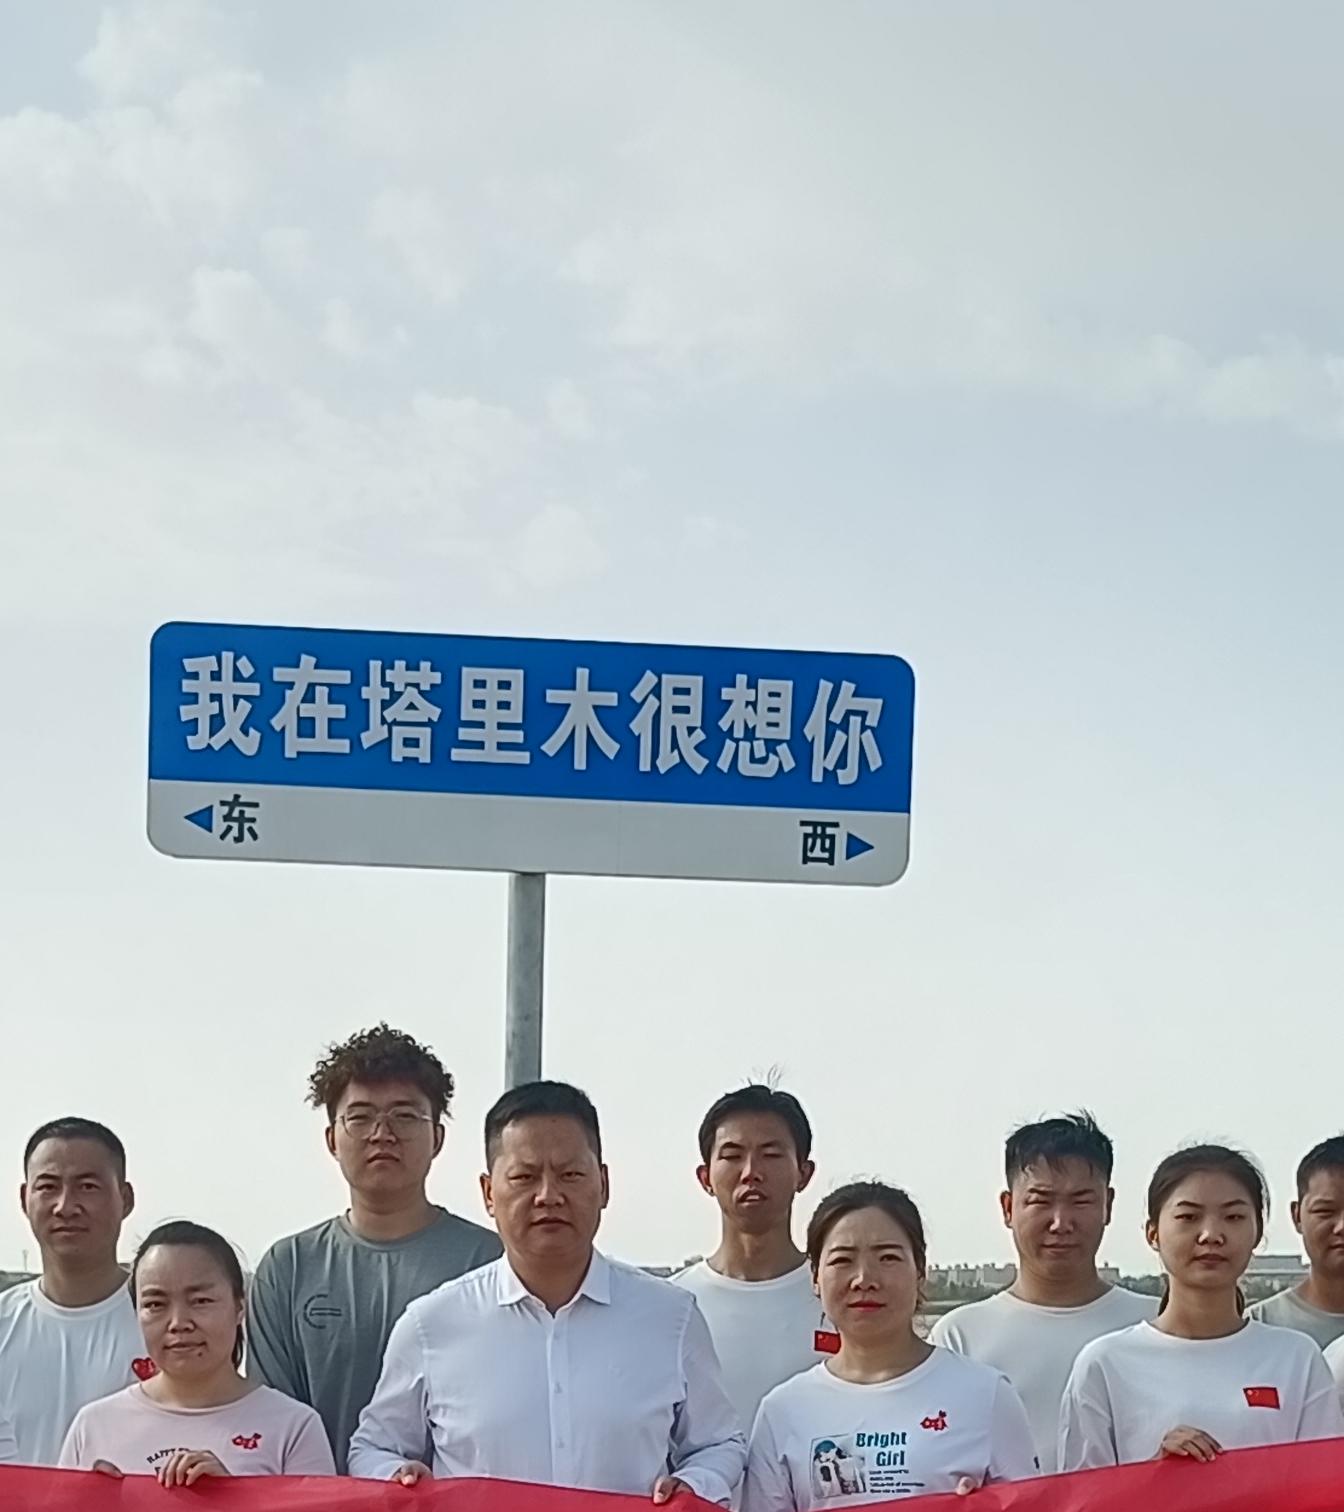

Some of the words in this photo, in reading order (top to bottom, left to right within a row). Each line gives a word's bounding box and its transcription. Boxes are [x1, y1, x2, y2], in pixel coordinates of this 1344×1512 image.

[179, 651, 884, 785] 我在塔里木很想你
[218, 794, 260, 844] 东
[800, 820, 840, 866] 西
[856, 1431, 907, 1448] Bright
[876, 1451, 905, 1467] Girl
